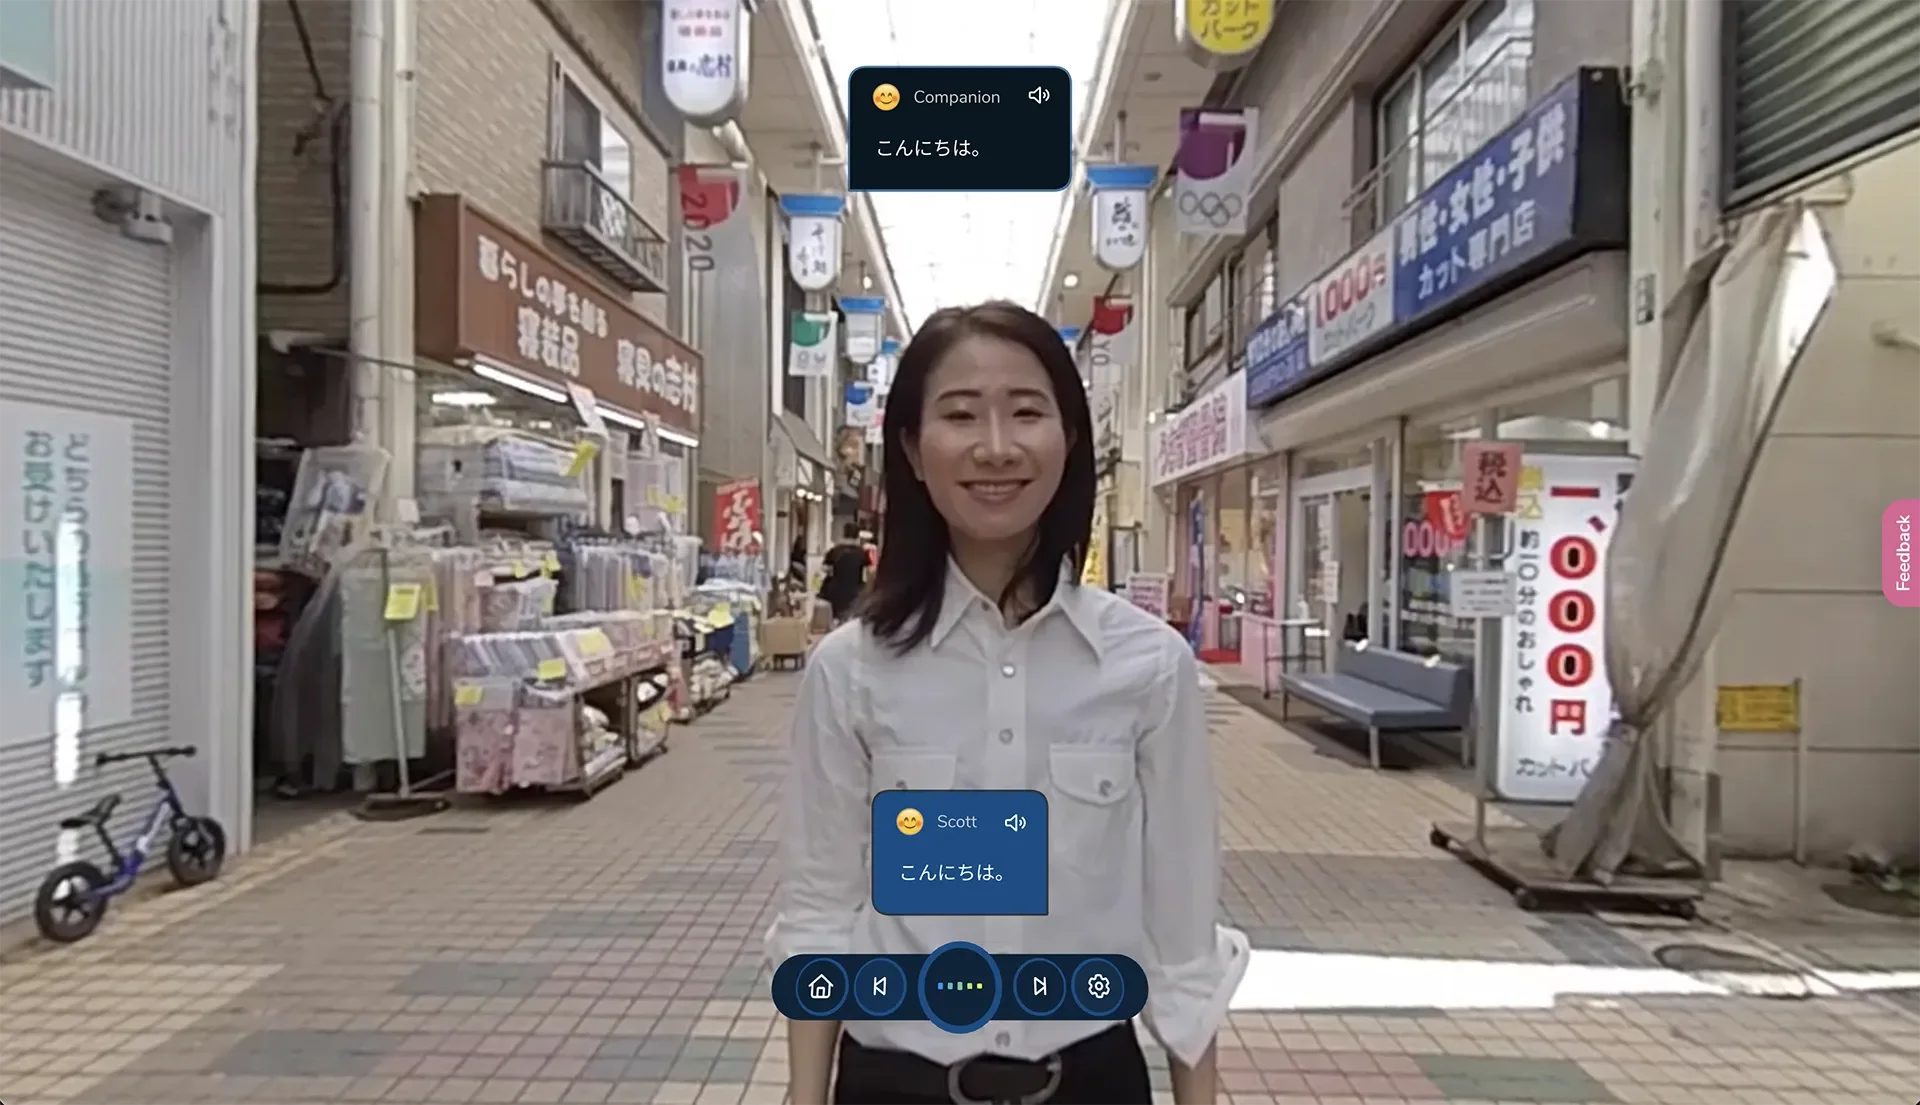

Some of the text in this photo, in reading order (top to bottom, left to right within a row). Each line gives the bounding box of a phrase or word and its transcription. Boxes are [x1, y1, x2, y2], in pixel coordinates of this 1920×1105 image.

[681, 191, 715, 271] 2020
[1418, 199, 1536, 300] カット専門店
[1475, 451, 1507, 503] 税込
